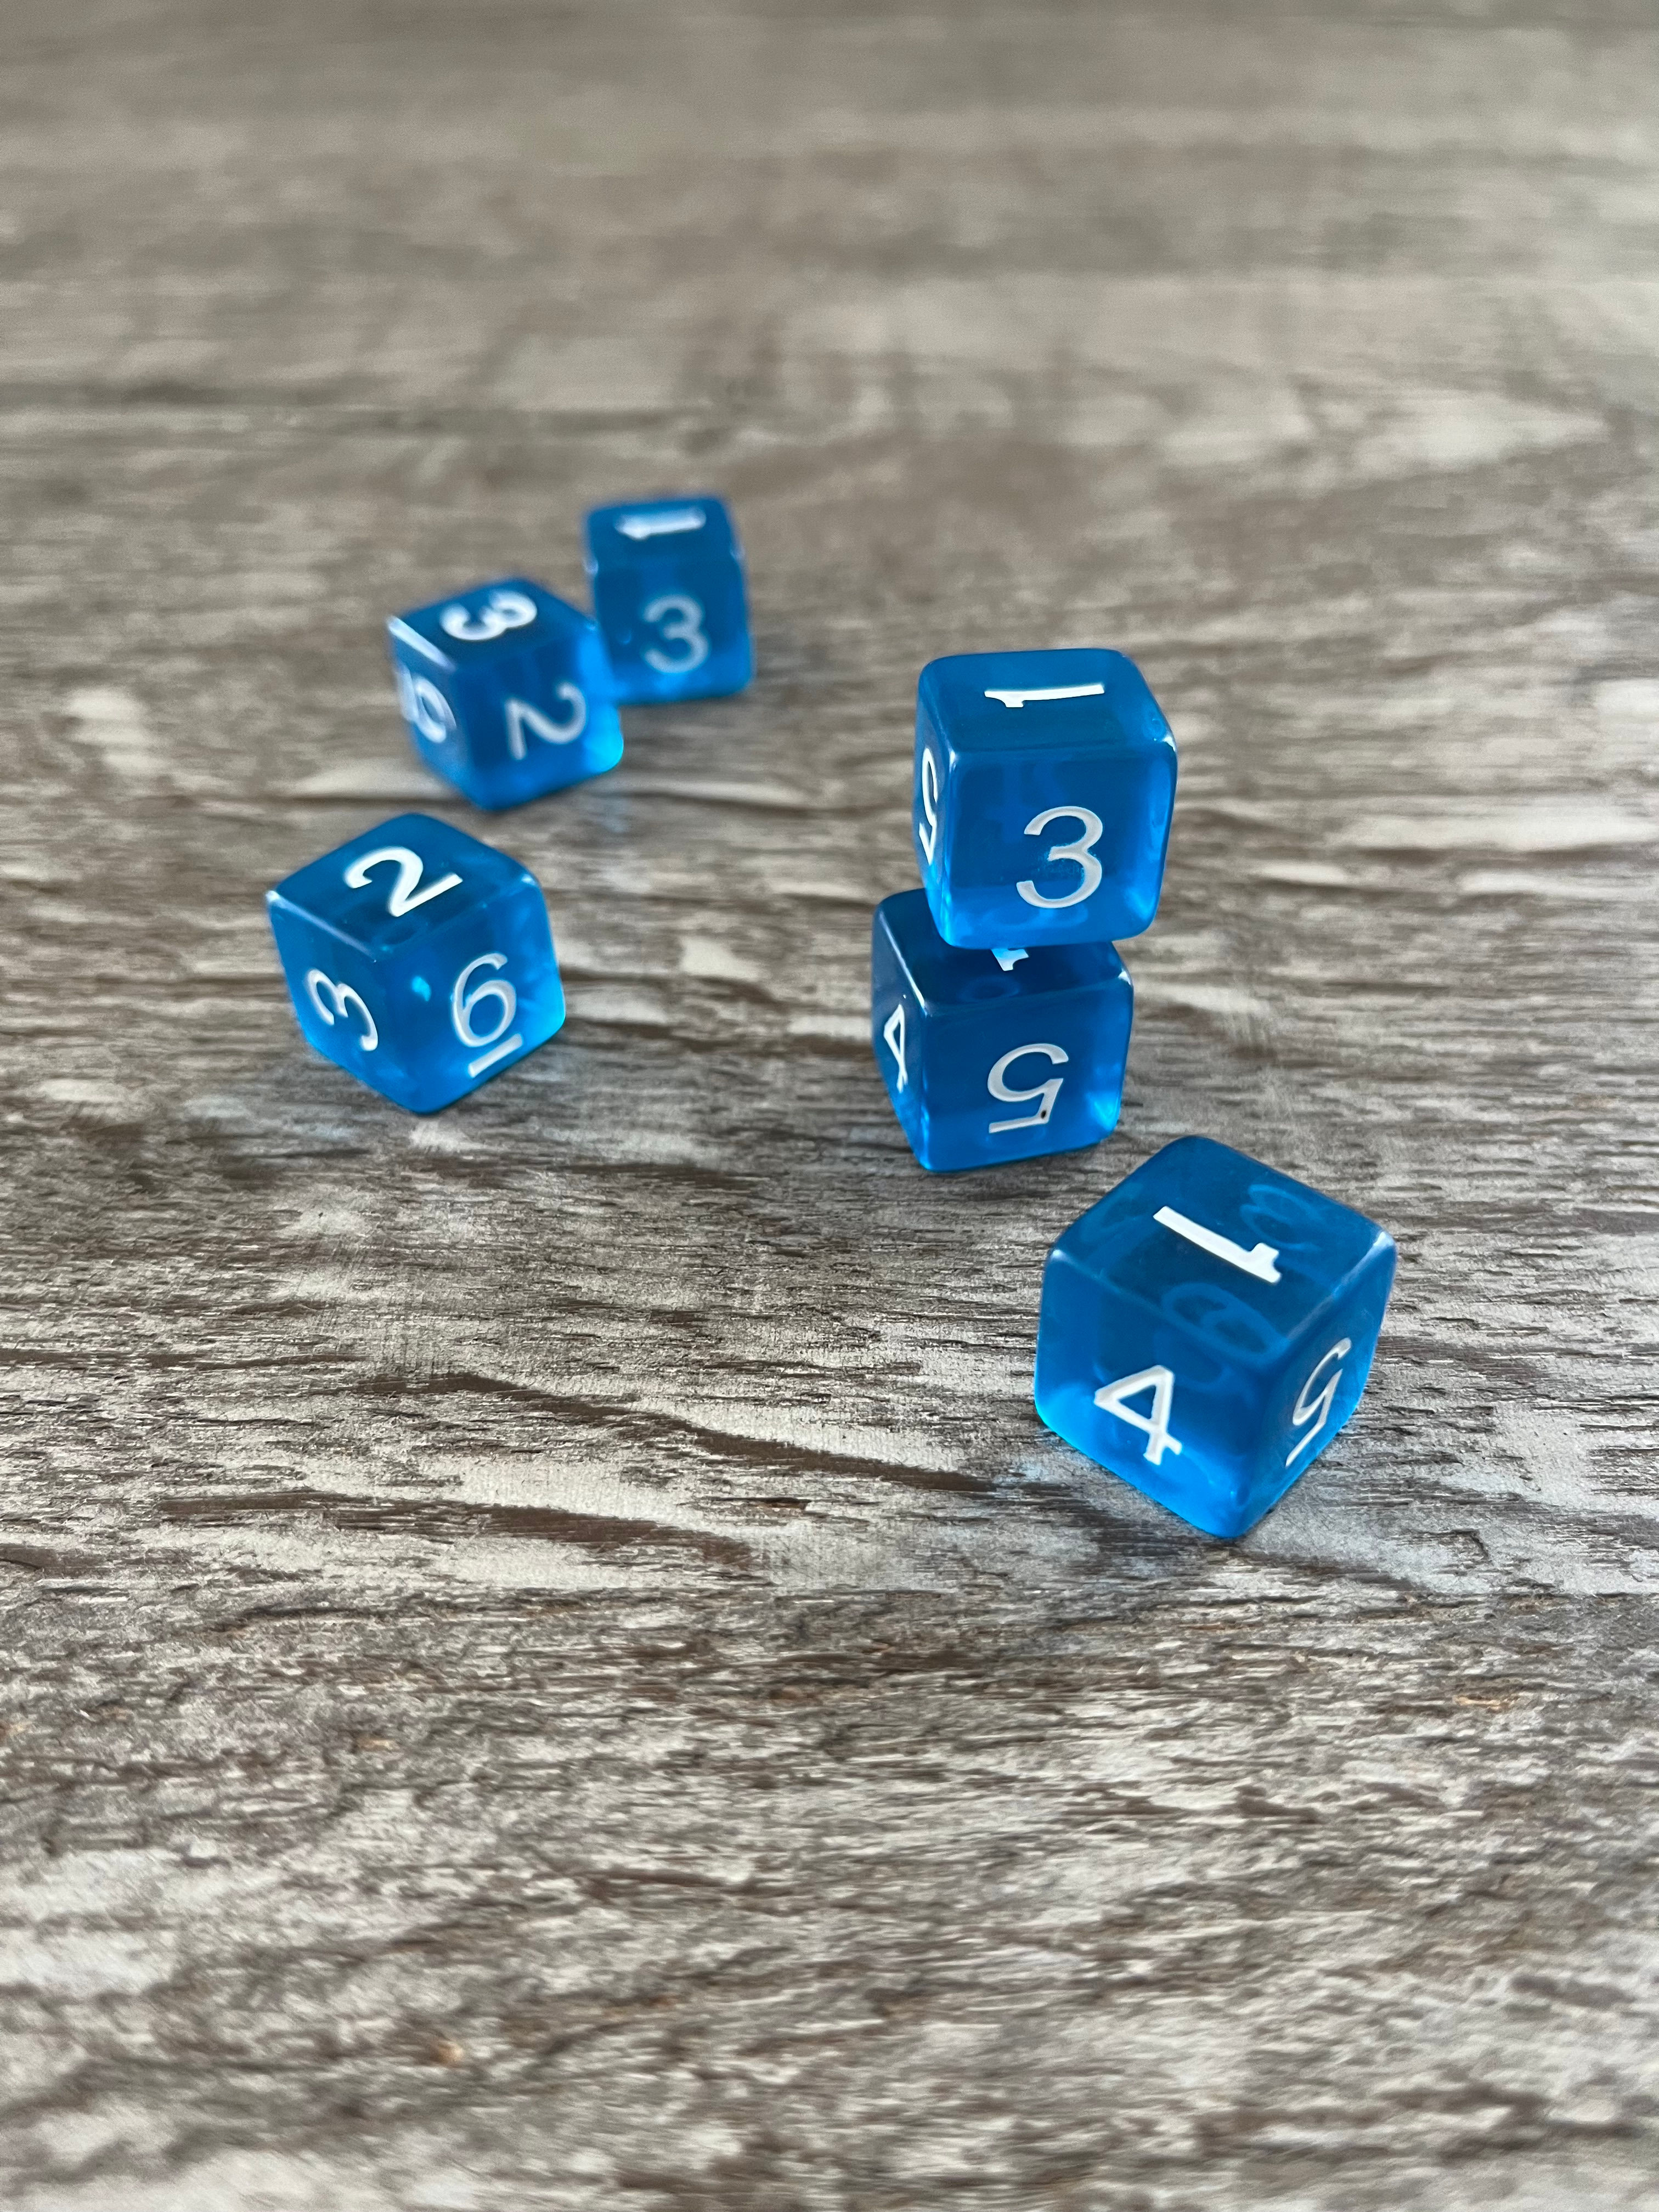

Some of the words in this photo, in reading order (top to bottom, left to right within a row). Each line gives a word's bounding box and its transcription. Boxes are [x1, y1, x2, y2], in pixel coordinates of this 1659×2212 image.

[613, 507, 706, 540] 1
[440, 590, 538, 640] 3
[642, 594, 709, 673] 3
[504, 681, 586, 760] 2
[984, 683, 1105, 708] 1
[343, 846, 463, 917] 2
[1016, 805, 1104, 909] 3
[306, 968, 378, 1051] 3
[452, 952, 523, 1078] 6
[884, 1004, 908, 1093] 4
[988, 1043, 1069, 1134] 5
[1153, 1205, 1281, 1284] 1
[1094, 1364, 1183, 1465] 4
[1285, 1338, 1352, 1467] 5
